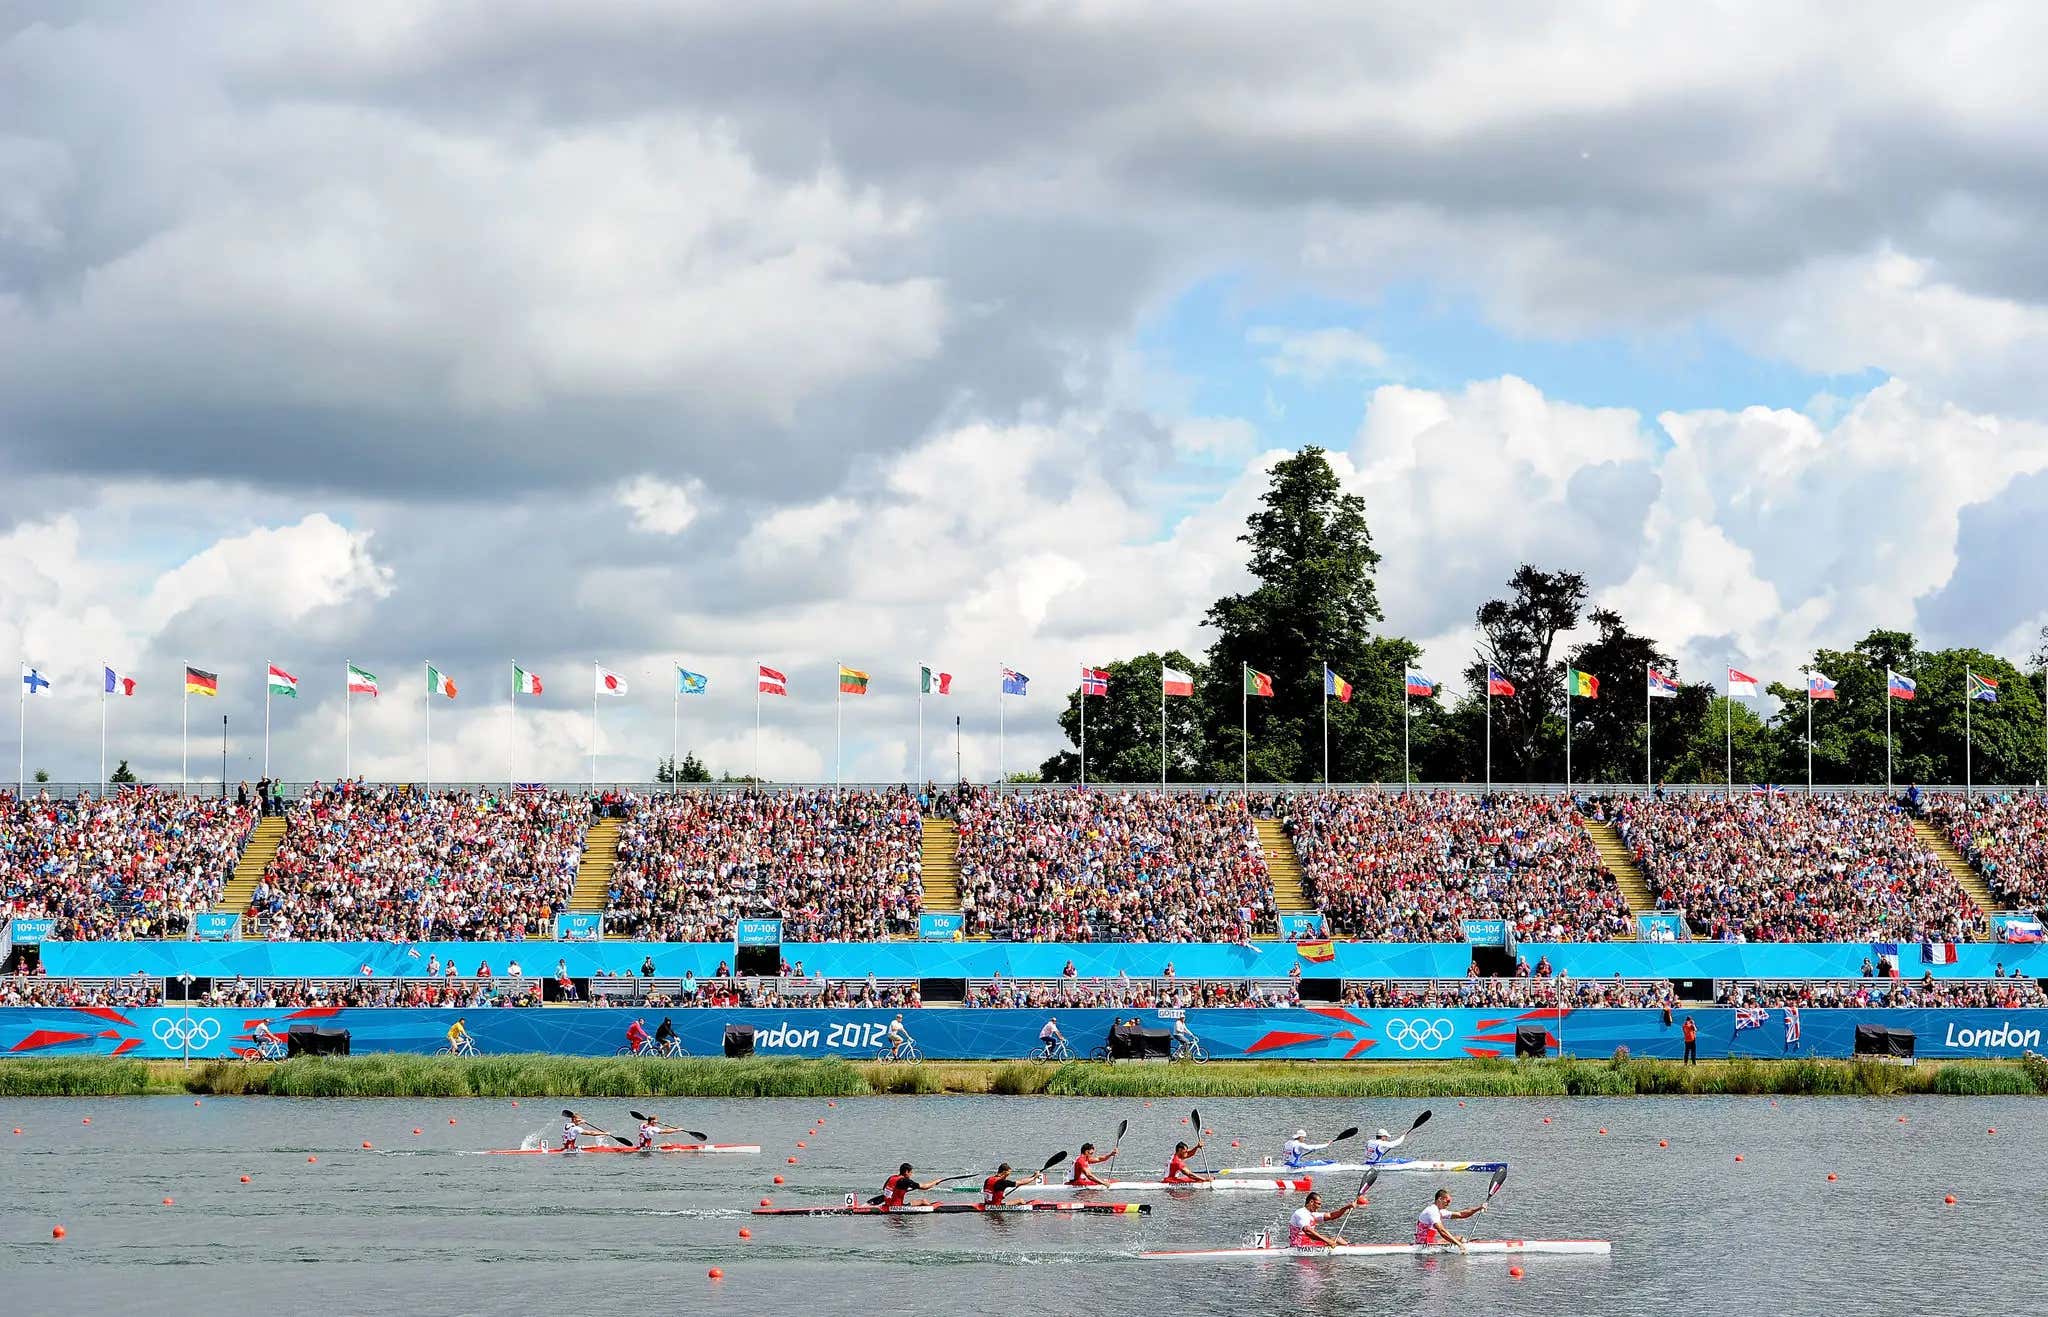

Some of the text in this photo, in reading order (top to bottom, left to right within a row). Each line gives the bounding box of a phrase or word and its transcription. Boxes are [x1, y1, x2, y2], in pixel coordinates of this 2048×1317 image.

[211, 918, 226, 926] 108
[573, 918, 588, 927] 107
[934, 918, 950, 927] 106
[744, 924, 777, 933] 107-106
[1466, 924, 1500, 934] 105-104
[722, 1021, 887, 1047] ndon 2012
[1945, 1021, 2040, 1047] London
[846, 1194, 853, 1205] 6
[1256, 1234, 1264, 1246] 7
